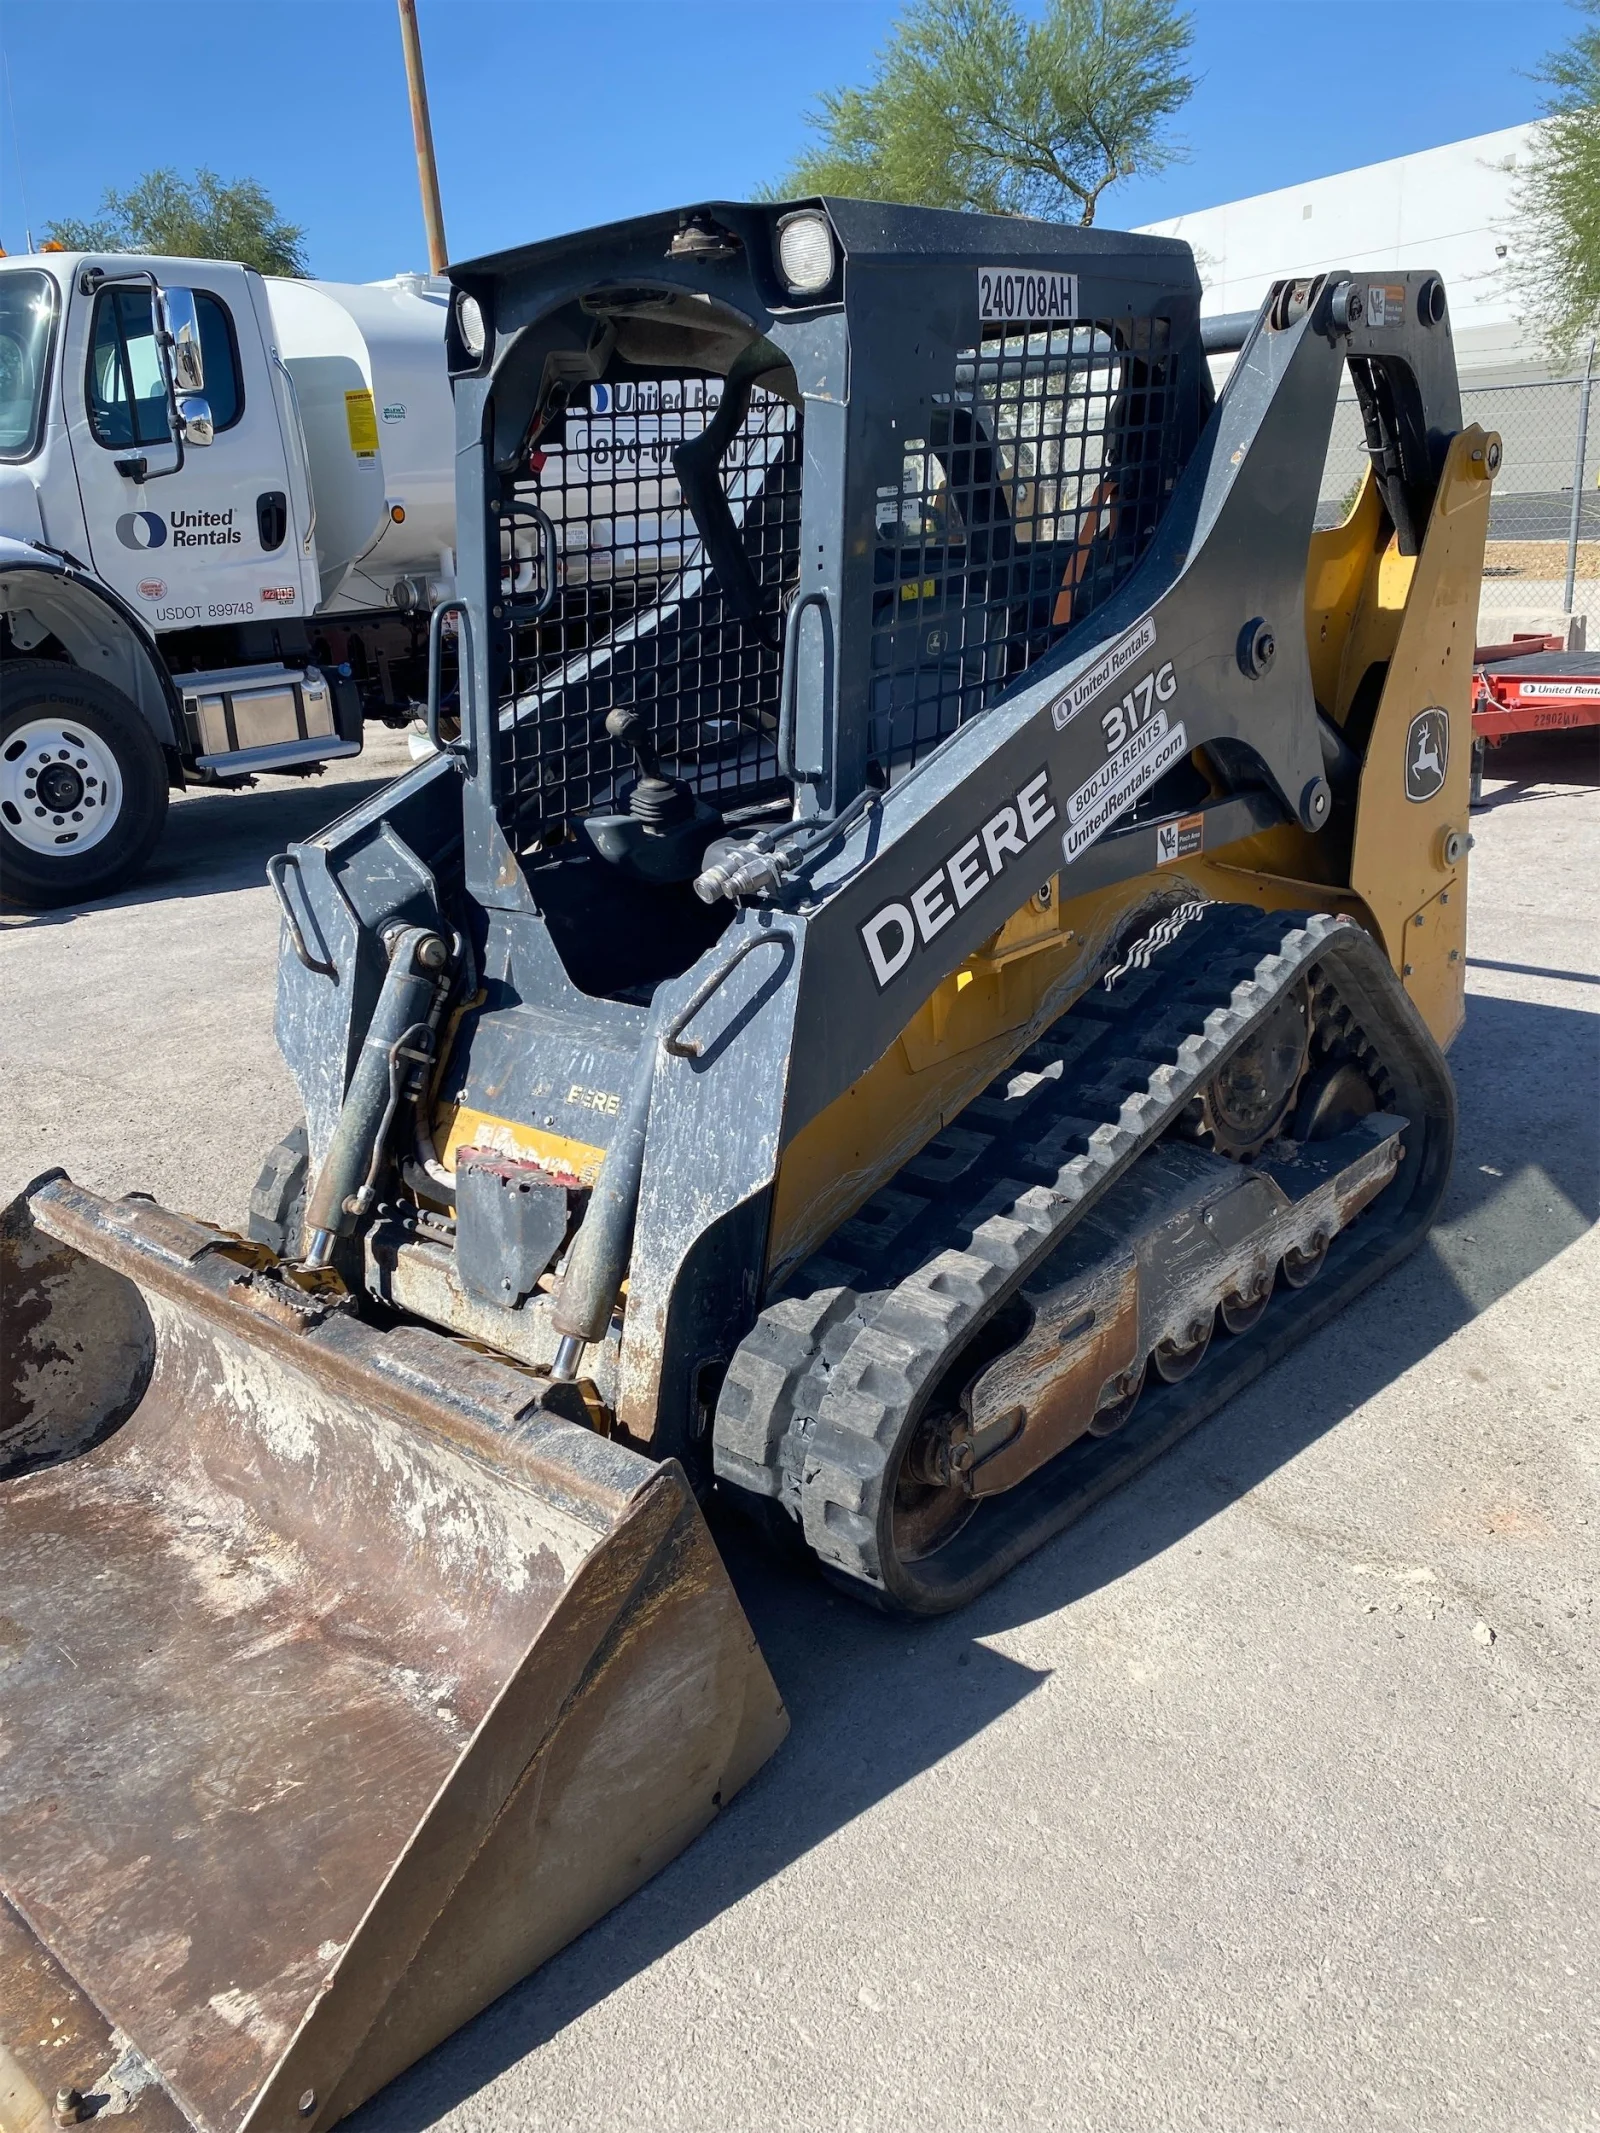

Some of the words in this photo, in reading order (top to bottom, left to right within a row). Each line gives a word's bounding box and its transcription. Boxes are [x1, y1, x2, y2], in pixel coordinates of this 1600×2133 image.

[982, 275, 1072, 317] 240708AH
[171, 508, 233, 528] United
[173, 528, 241, 547] Rentals
[156, 606, 202, 621] USDOT
[208, 602, 254, 618] 899748
[276, 588, 294, 600] 106
[1074, 662, 1110, 707] United
[1112, 629, 1150, 671] Rentals
[1102, 662, 1177, 753] 317G
[1538, 685, 1572, 695] United
[1076, 720, 1161, 812] 800-UR-RENTS
[1068, 733, 1182, 854] UnitedRentals.com
[862, 770, 1056, 987] DEERE
